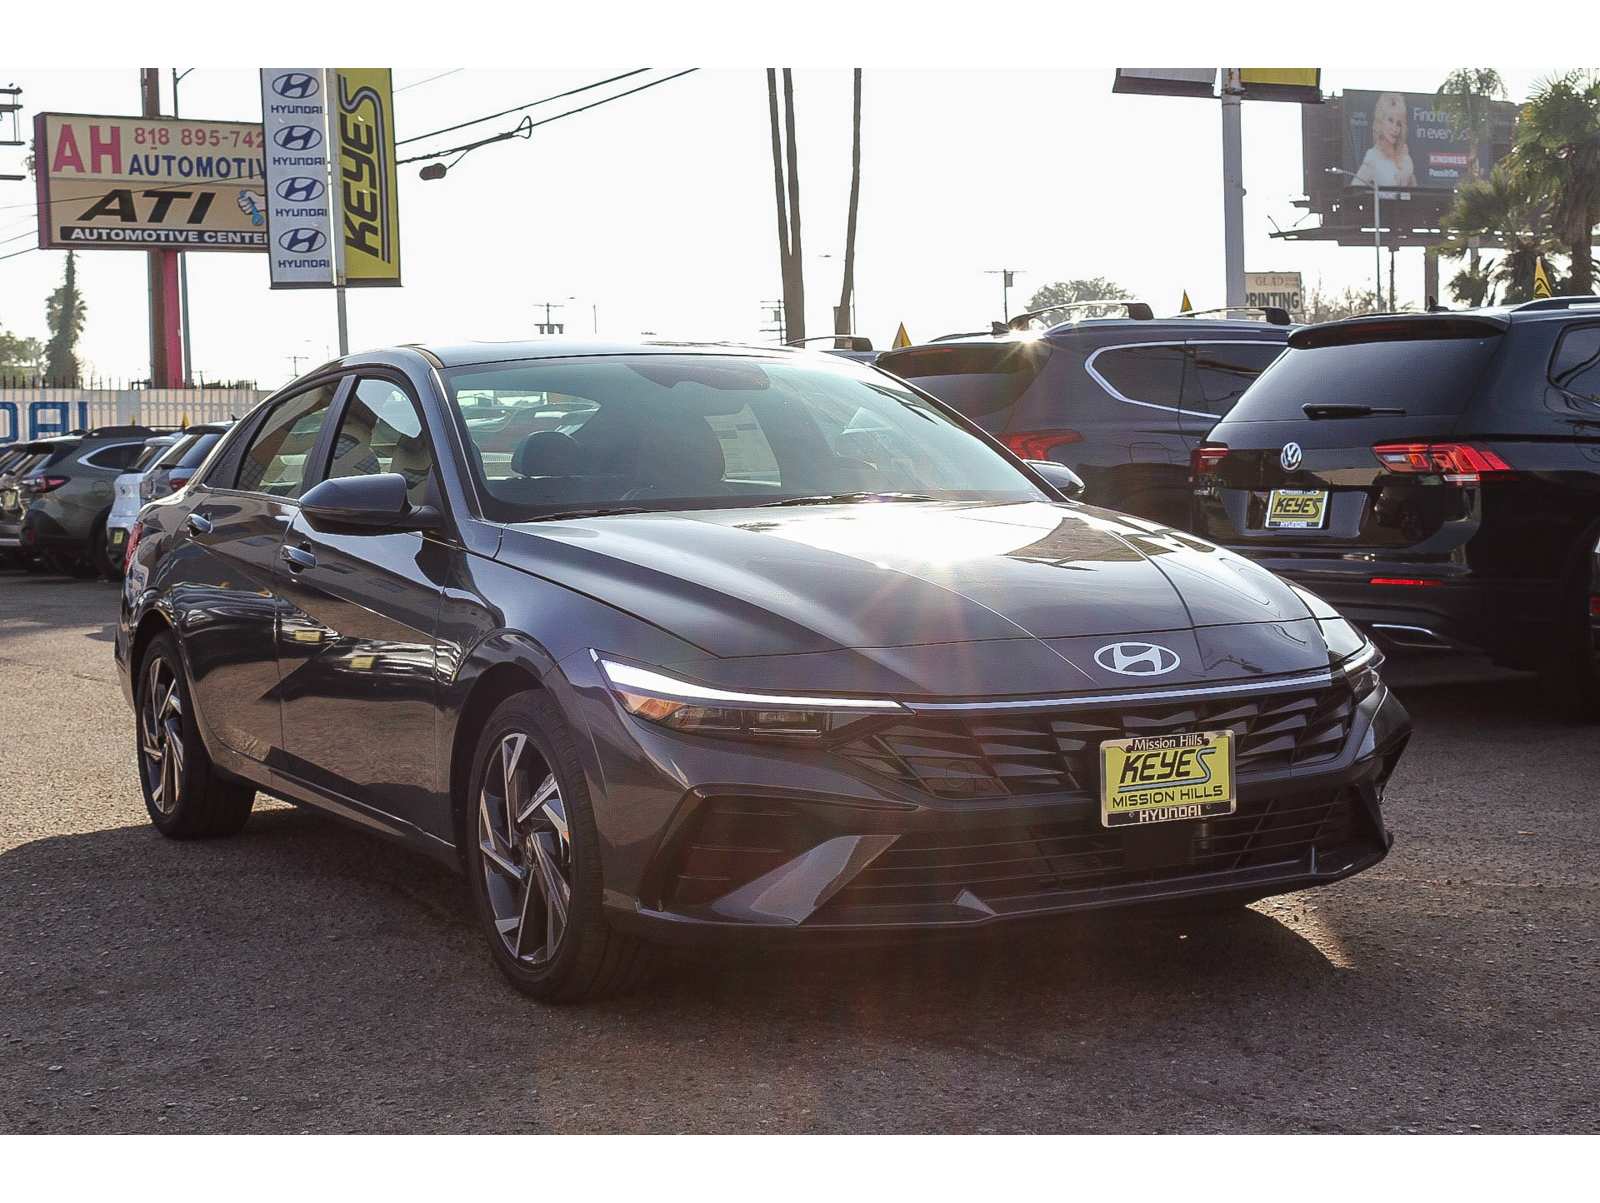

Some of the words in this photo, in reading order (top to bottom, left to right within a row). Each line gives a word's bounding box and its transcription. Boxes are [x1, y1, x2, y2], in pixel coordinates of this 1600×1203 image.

[271, 105, 323, 114] HYUNDAI
[135, 127, 170, 146] 818
[52, 124, 122, 174] AH
[273, 157, 325, 166] HYUNDAI
[338, 74, 391, 264] KEYES
[77, 189, 216, 224] ATI
[275, 208, 327, 217] HYUNDAI
[71, 228, 199, 242] AUTOMOTIVE
[278, 259, 330, 268] HYUNDAI
[1246, 292, 1299, 310] RINTING
[1272, 498, 1324, 518] KEYES
[1134, 737, 1176, 752] Mission
[1180, 735, 1203, 747] Hills
[1118, 746, 1217, 793] KEYES
[1112, 791, 1175, 808] MISSION
[1180, 785, 1223, 801] HILLS
[1139, 804, 1202, 821] HYUNDAI
